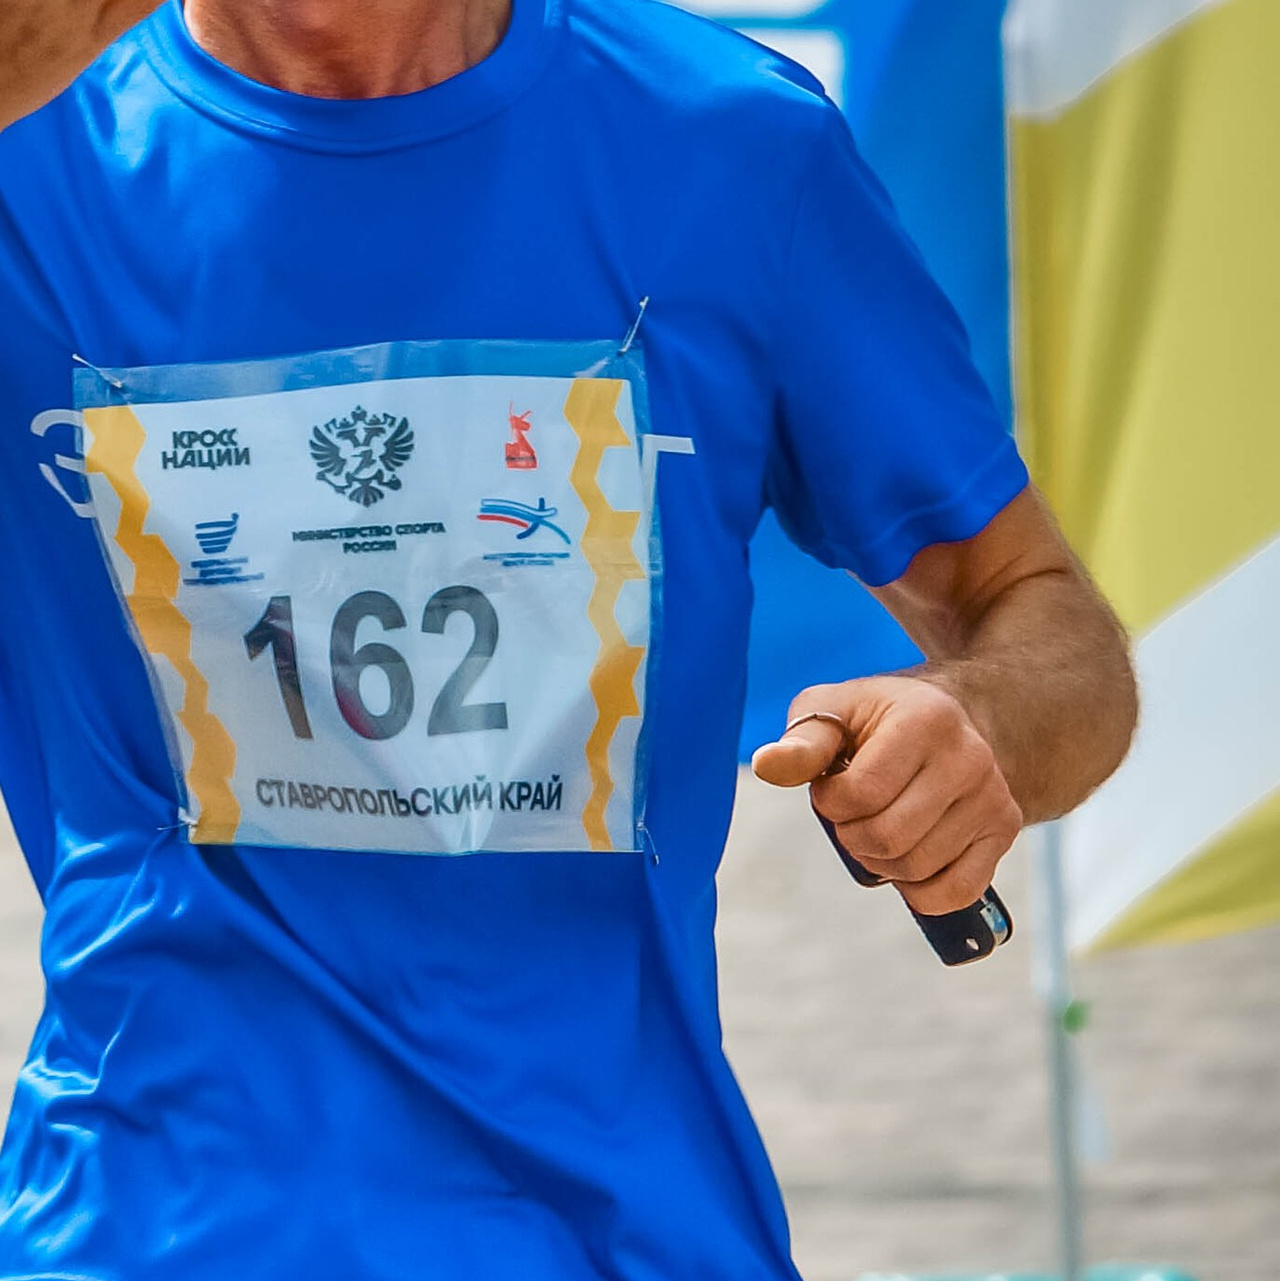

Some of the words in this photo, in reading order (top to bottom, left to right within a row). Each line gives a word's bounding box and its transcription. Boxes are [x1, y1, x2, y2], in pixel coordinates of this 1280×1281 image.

[172, 428, 238, 449] КРОСС
[162, 447, 251, 470] НАЦИИ
[343, 540, 397, 553] РОССИИ
[242, 584, 509, 742] 162
[255, 774, 493, 817] СТАВРОПОЛЬСКИЙ
[499, 773, 563, 812] КРАЙ
